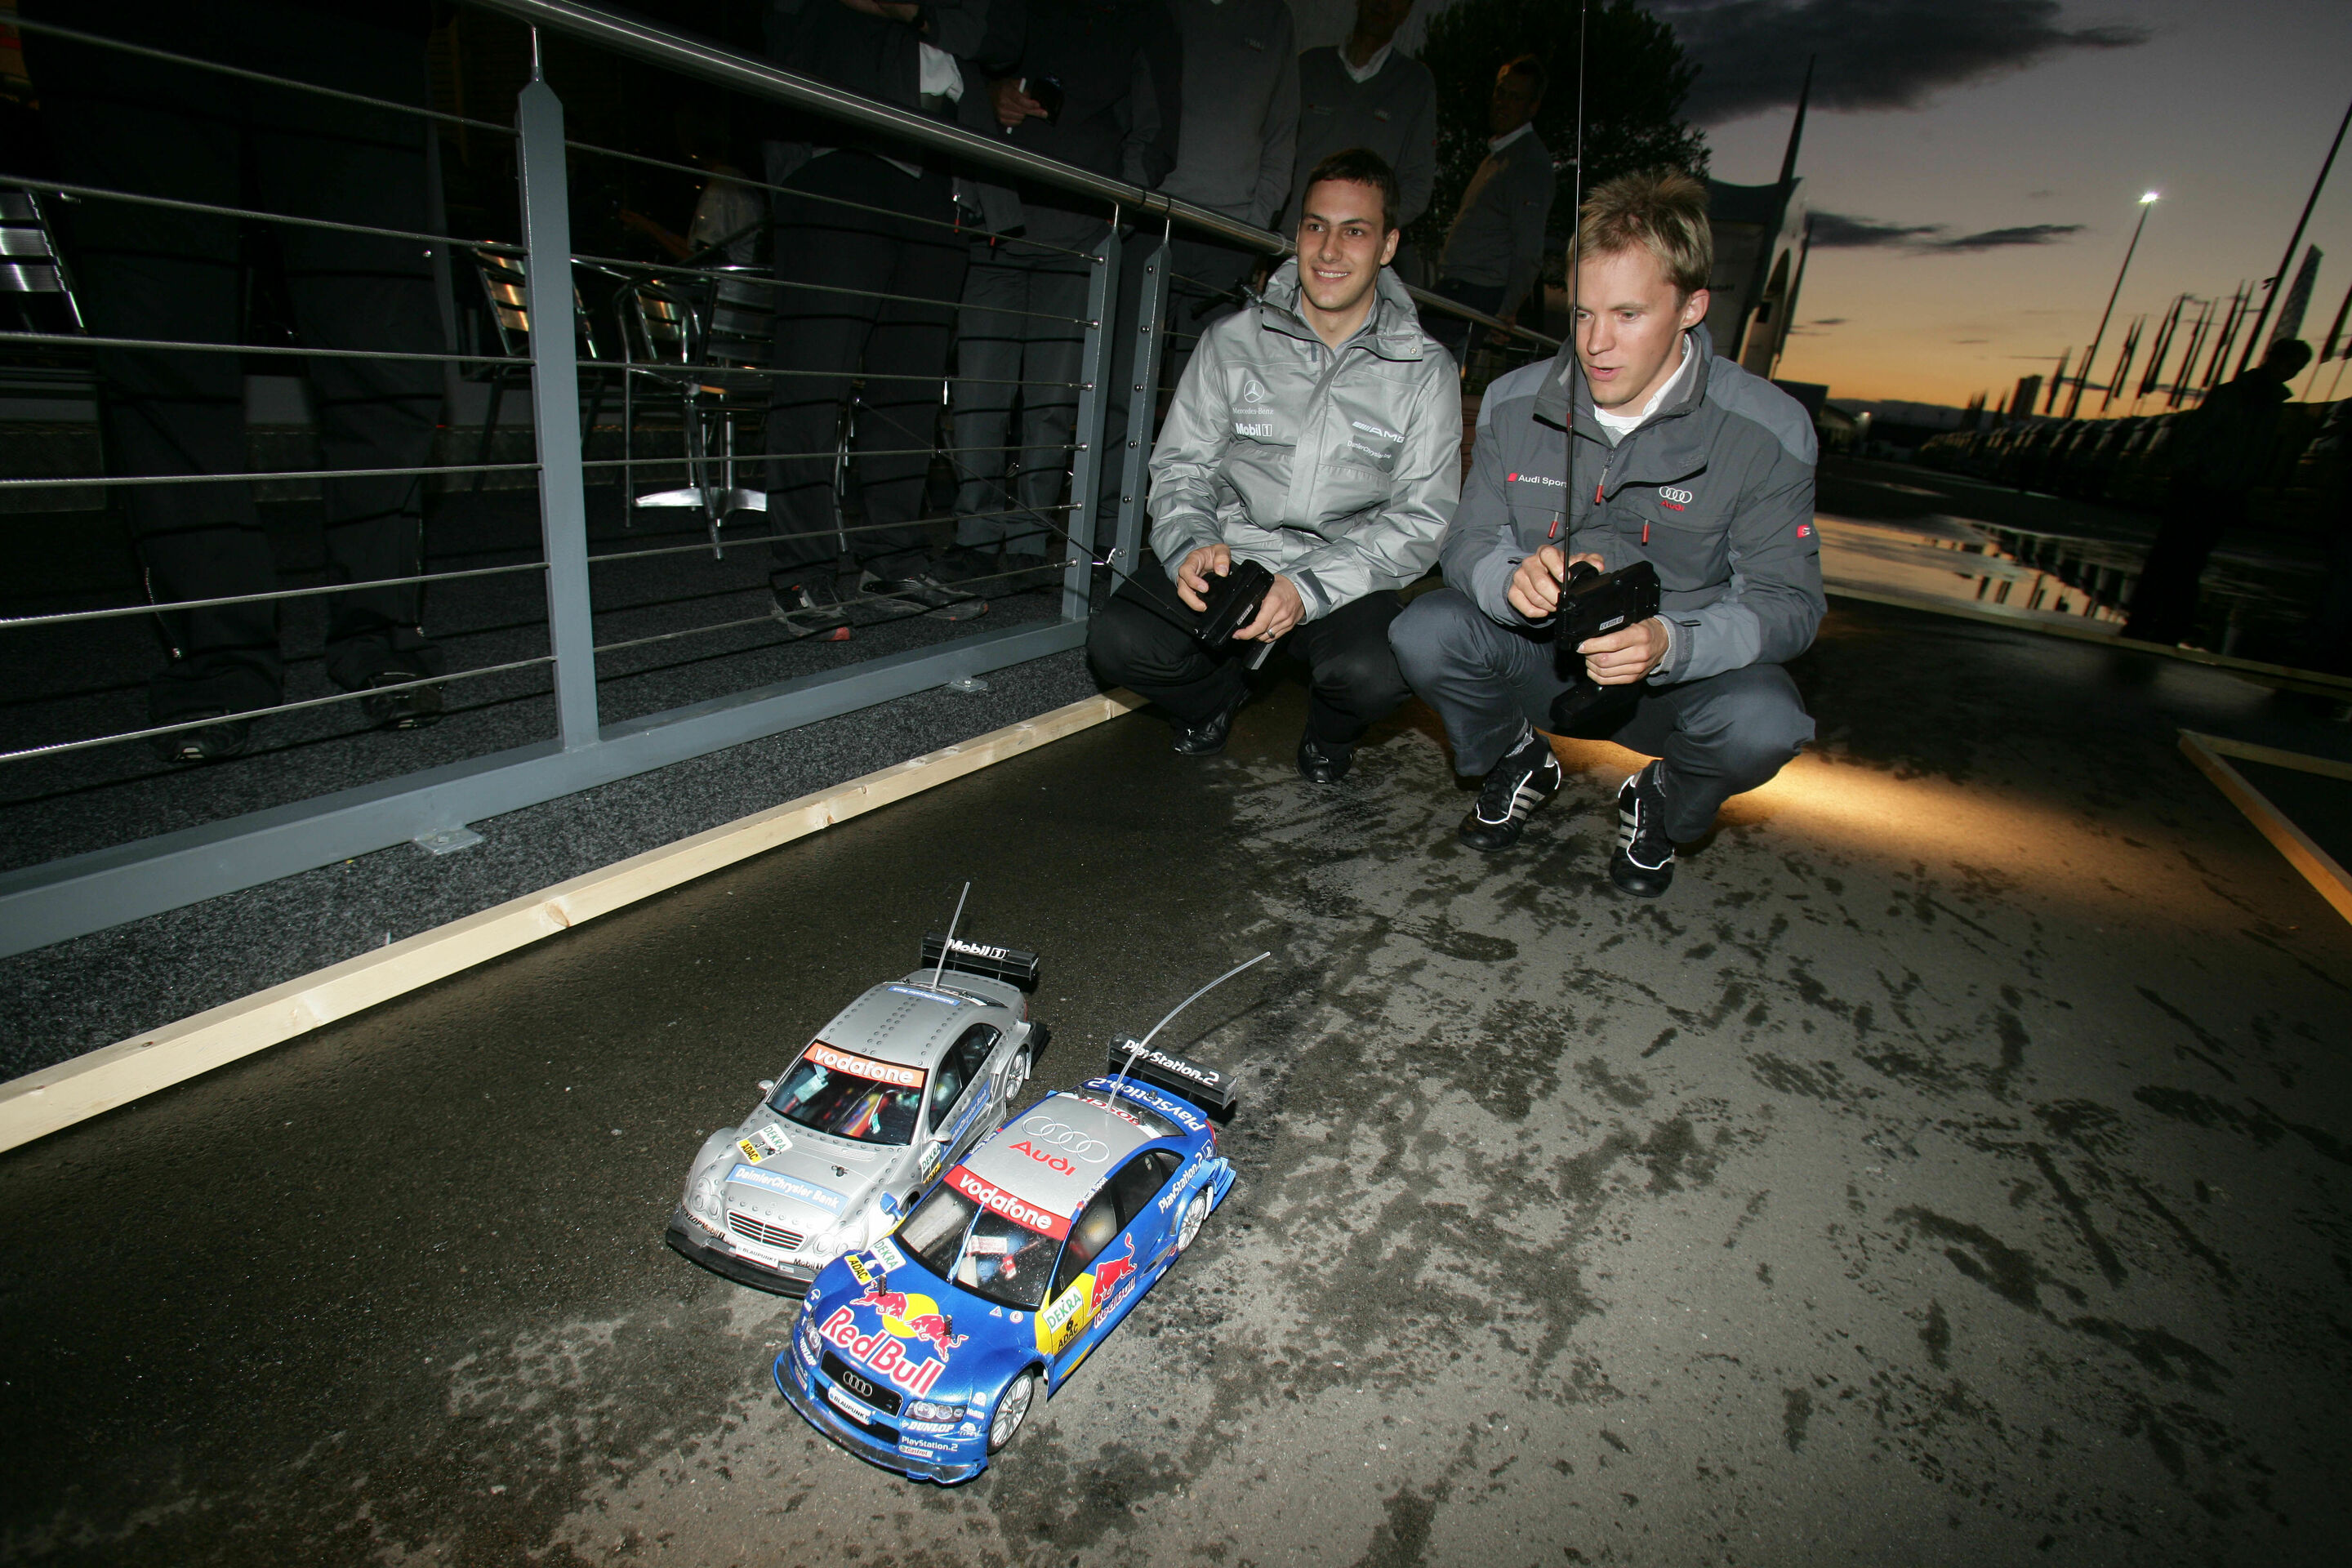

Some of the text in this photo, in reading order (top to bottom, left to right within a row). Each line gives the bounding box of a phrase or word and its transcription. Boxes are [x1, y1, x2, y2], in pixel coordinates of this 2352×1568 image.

[1236, 422, 1262, 437] Mobil
[1518, 474, 1540, 483] Audi
[1659, 499, 1686, 512] Audi
[948, 938, 991, 956] Mobil
[813, 1048, 914, 1084] vodafone
[764, 1126, 786, 1151] DEKRA
[741, 1143, 760, 1161] ADAC
[1008, 1140, 1076, 1177] Audi
[735, 1168, 840, 1209] DaimlerChrysler Bank
[959, 1174, 1053, 1230] vodafone
[742, 1247, 778, 1263] BLAUPUNKT
[874, 1241, 899, 1269] DEKRA
[849, 1260, 869, 1280] ADAC
[1046, 1293, 1081, 1329] DEKRA
[1058, 1324, 1079, 1351] ADAC
[834, 1396, 869, 1421] BLAUPUNKT
[908, 1421, 955, 1432] DUNLOP
